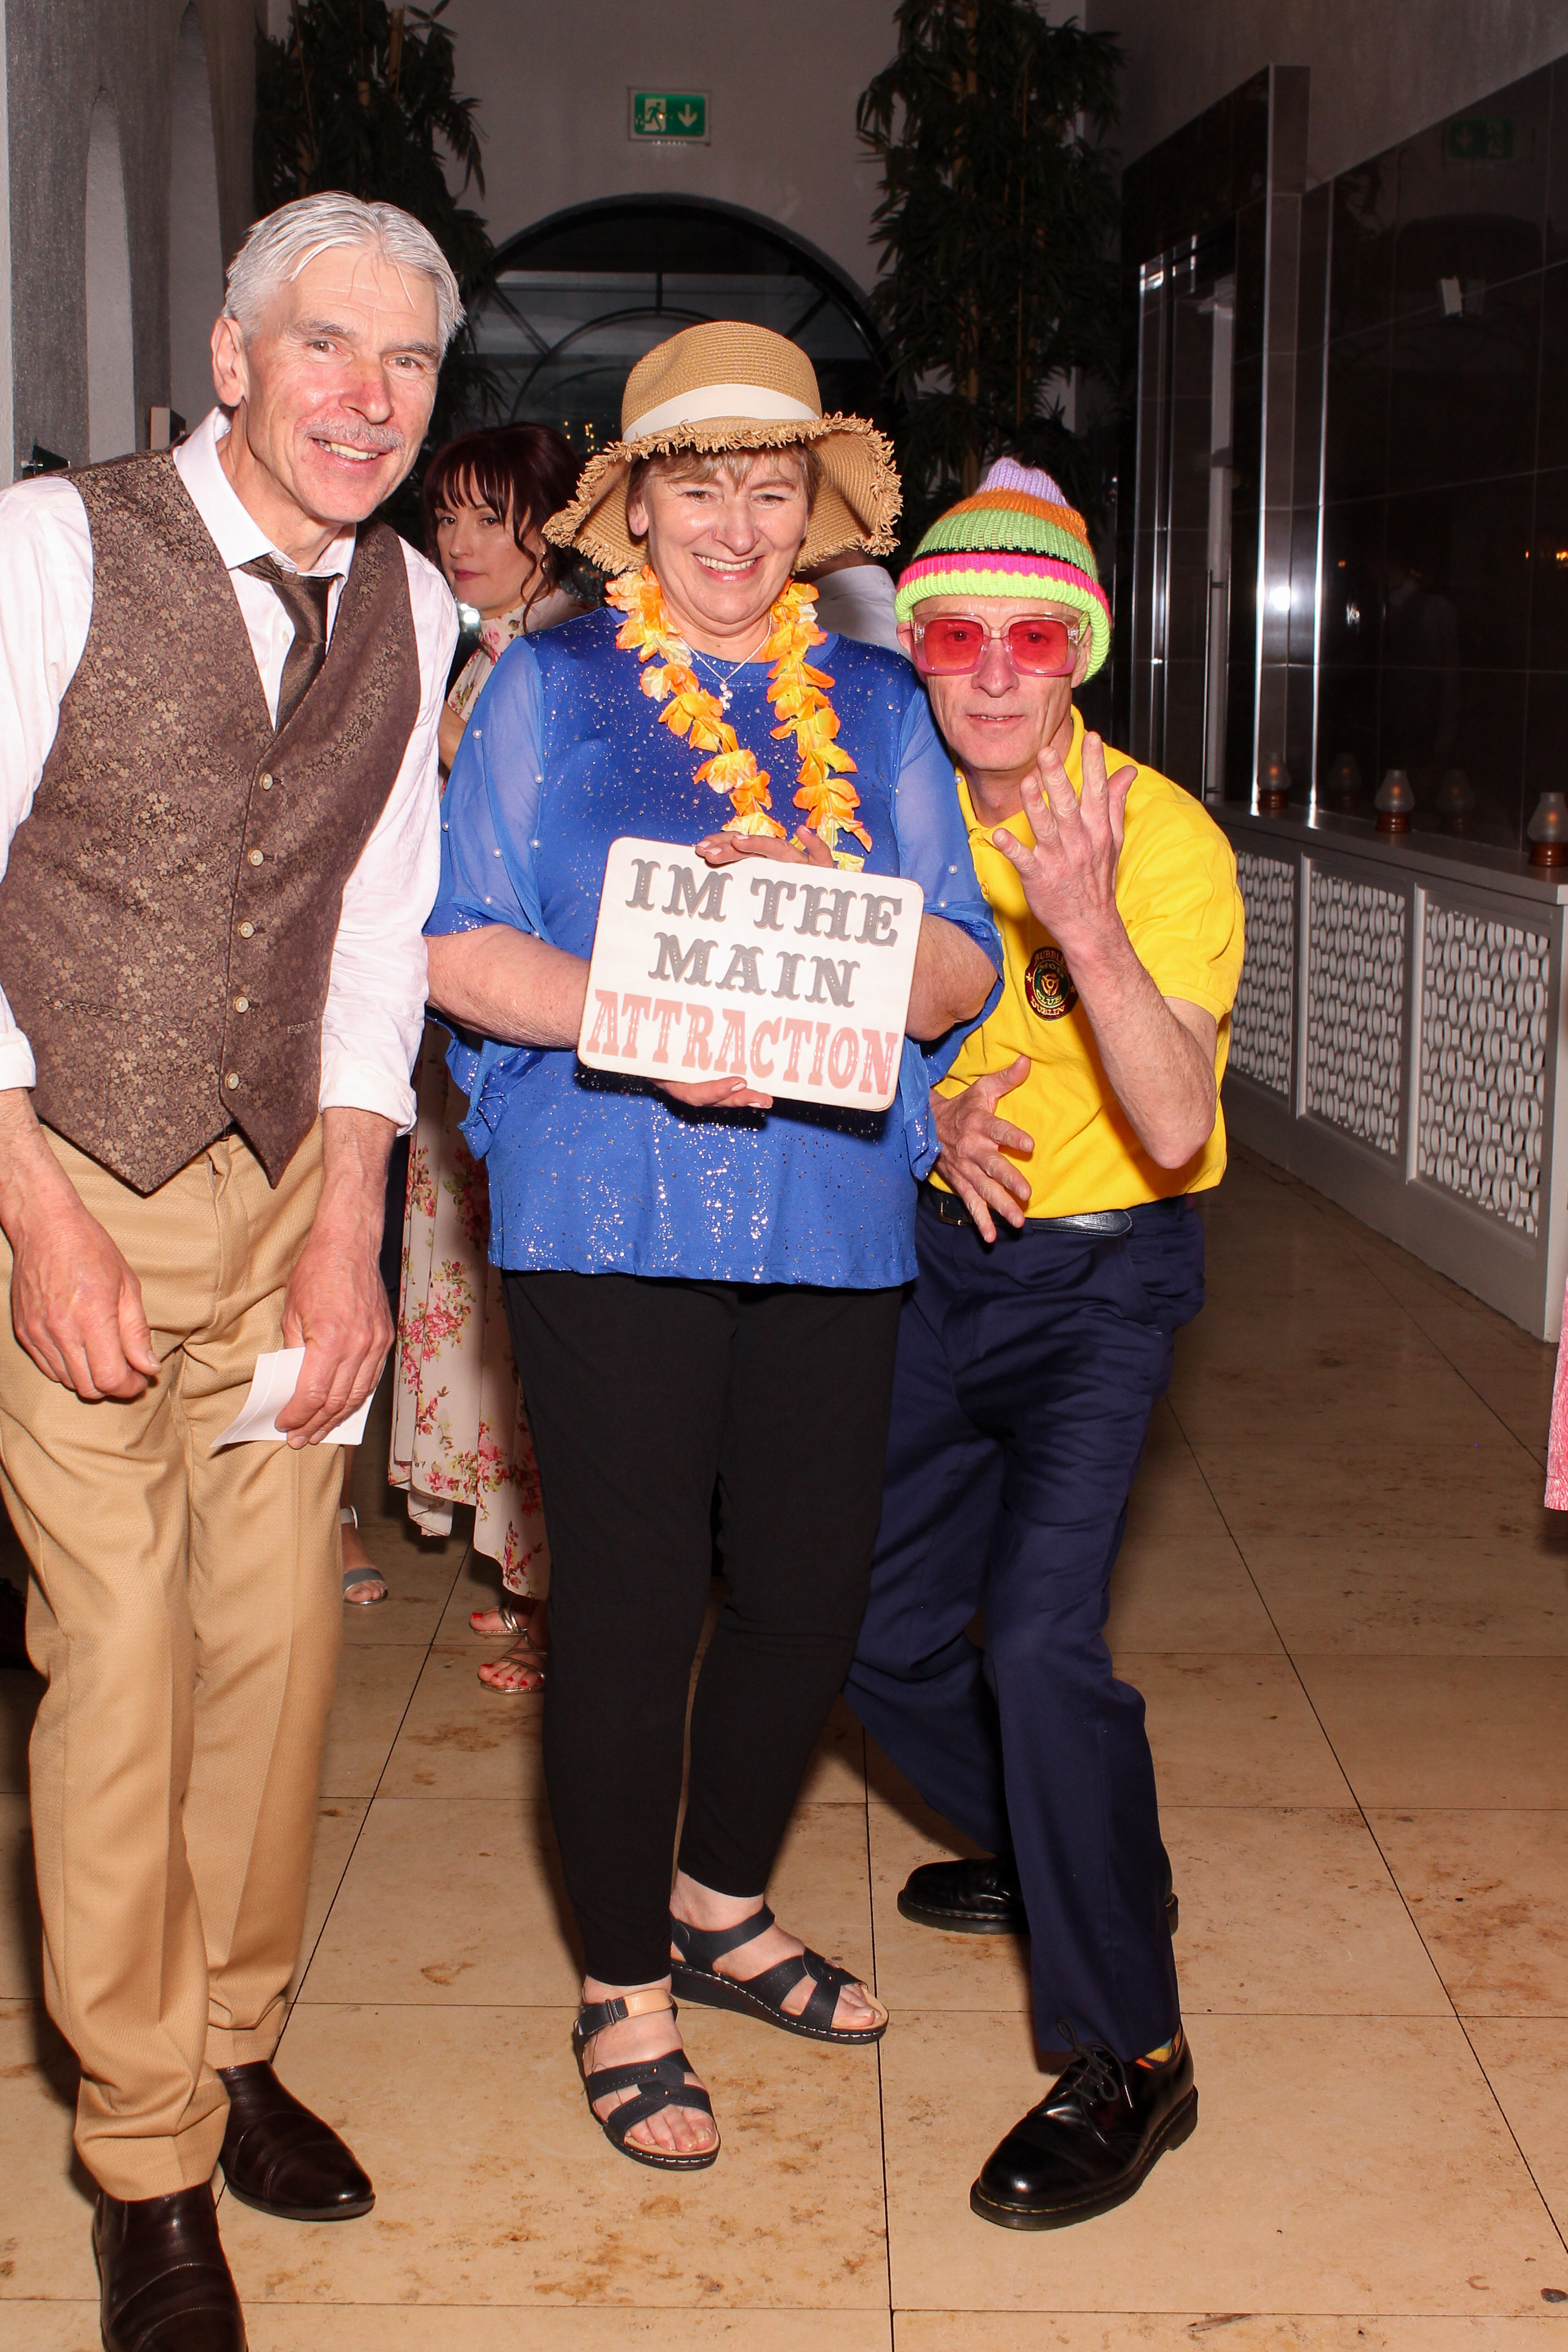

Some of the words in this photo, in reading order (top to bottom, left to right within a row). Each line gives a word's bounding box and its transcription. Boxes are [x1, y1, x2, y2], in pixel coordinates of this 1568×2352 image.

[625, 858, 733, 923] IM
[750, 876, 903, 947] THE
[648, 932, 861, 1008] MAIN
[1037, 962, 1064, 979] MOD
[1031, 995, 1065, 1015] DUBLIN
[1036, 989, 1062, 1005] CLUB
[586, 989, 899, 1096] ATTRACTION
